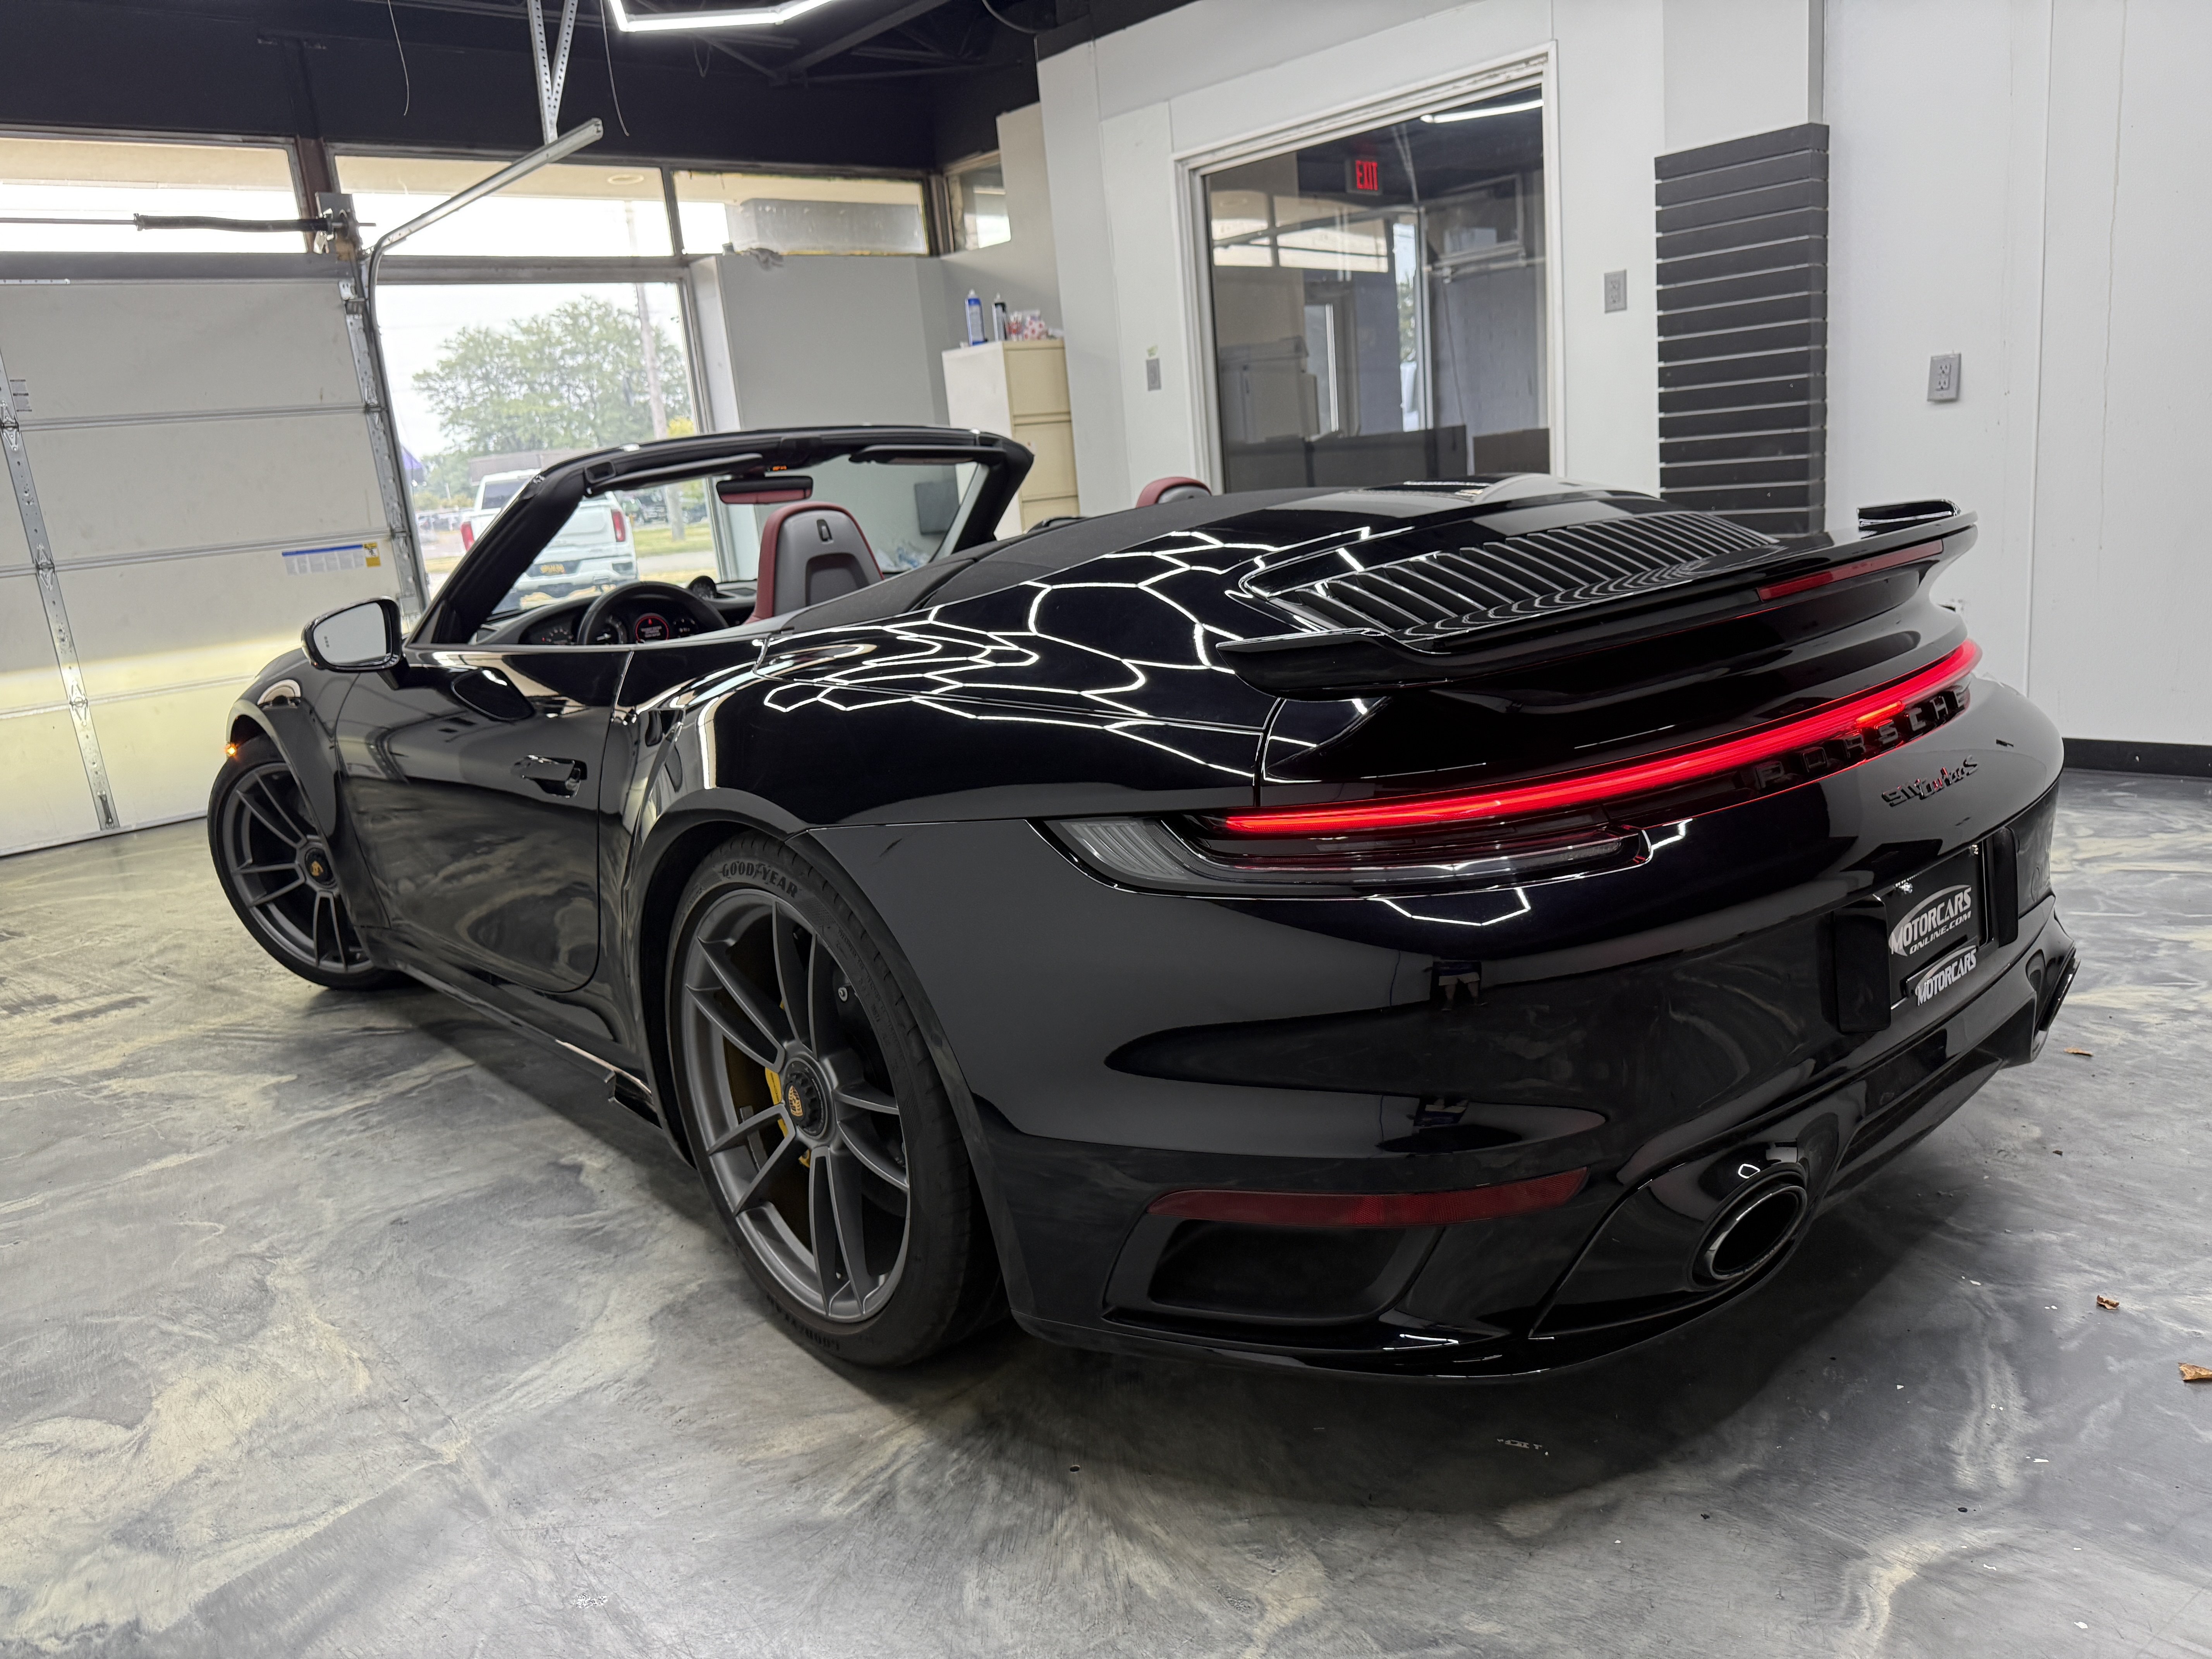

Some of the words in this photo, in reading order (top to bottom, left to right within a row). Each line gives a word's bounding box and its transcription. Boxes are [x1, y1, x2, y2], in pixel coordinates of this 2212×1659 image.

[1356, 160, 1378, 190] EXIT
[1755, 687, 1968, 790] PORSCHE
[722, 861, 799, 898] GOODYEAR
[1891, 887, 1972, 955] MOTORCARS
[1910, 910, 1972, 955] ONLINE.COM
[1918, 948, 1977, 1006] MOTORCARS
